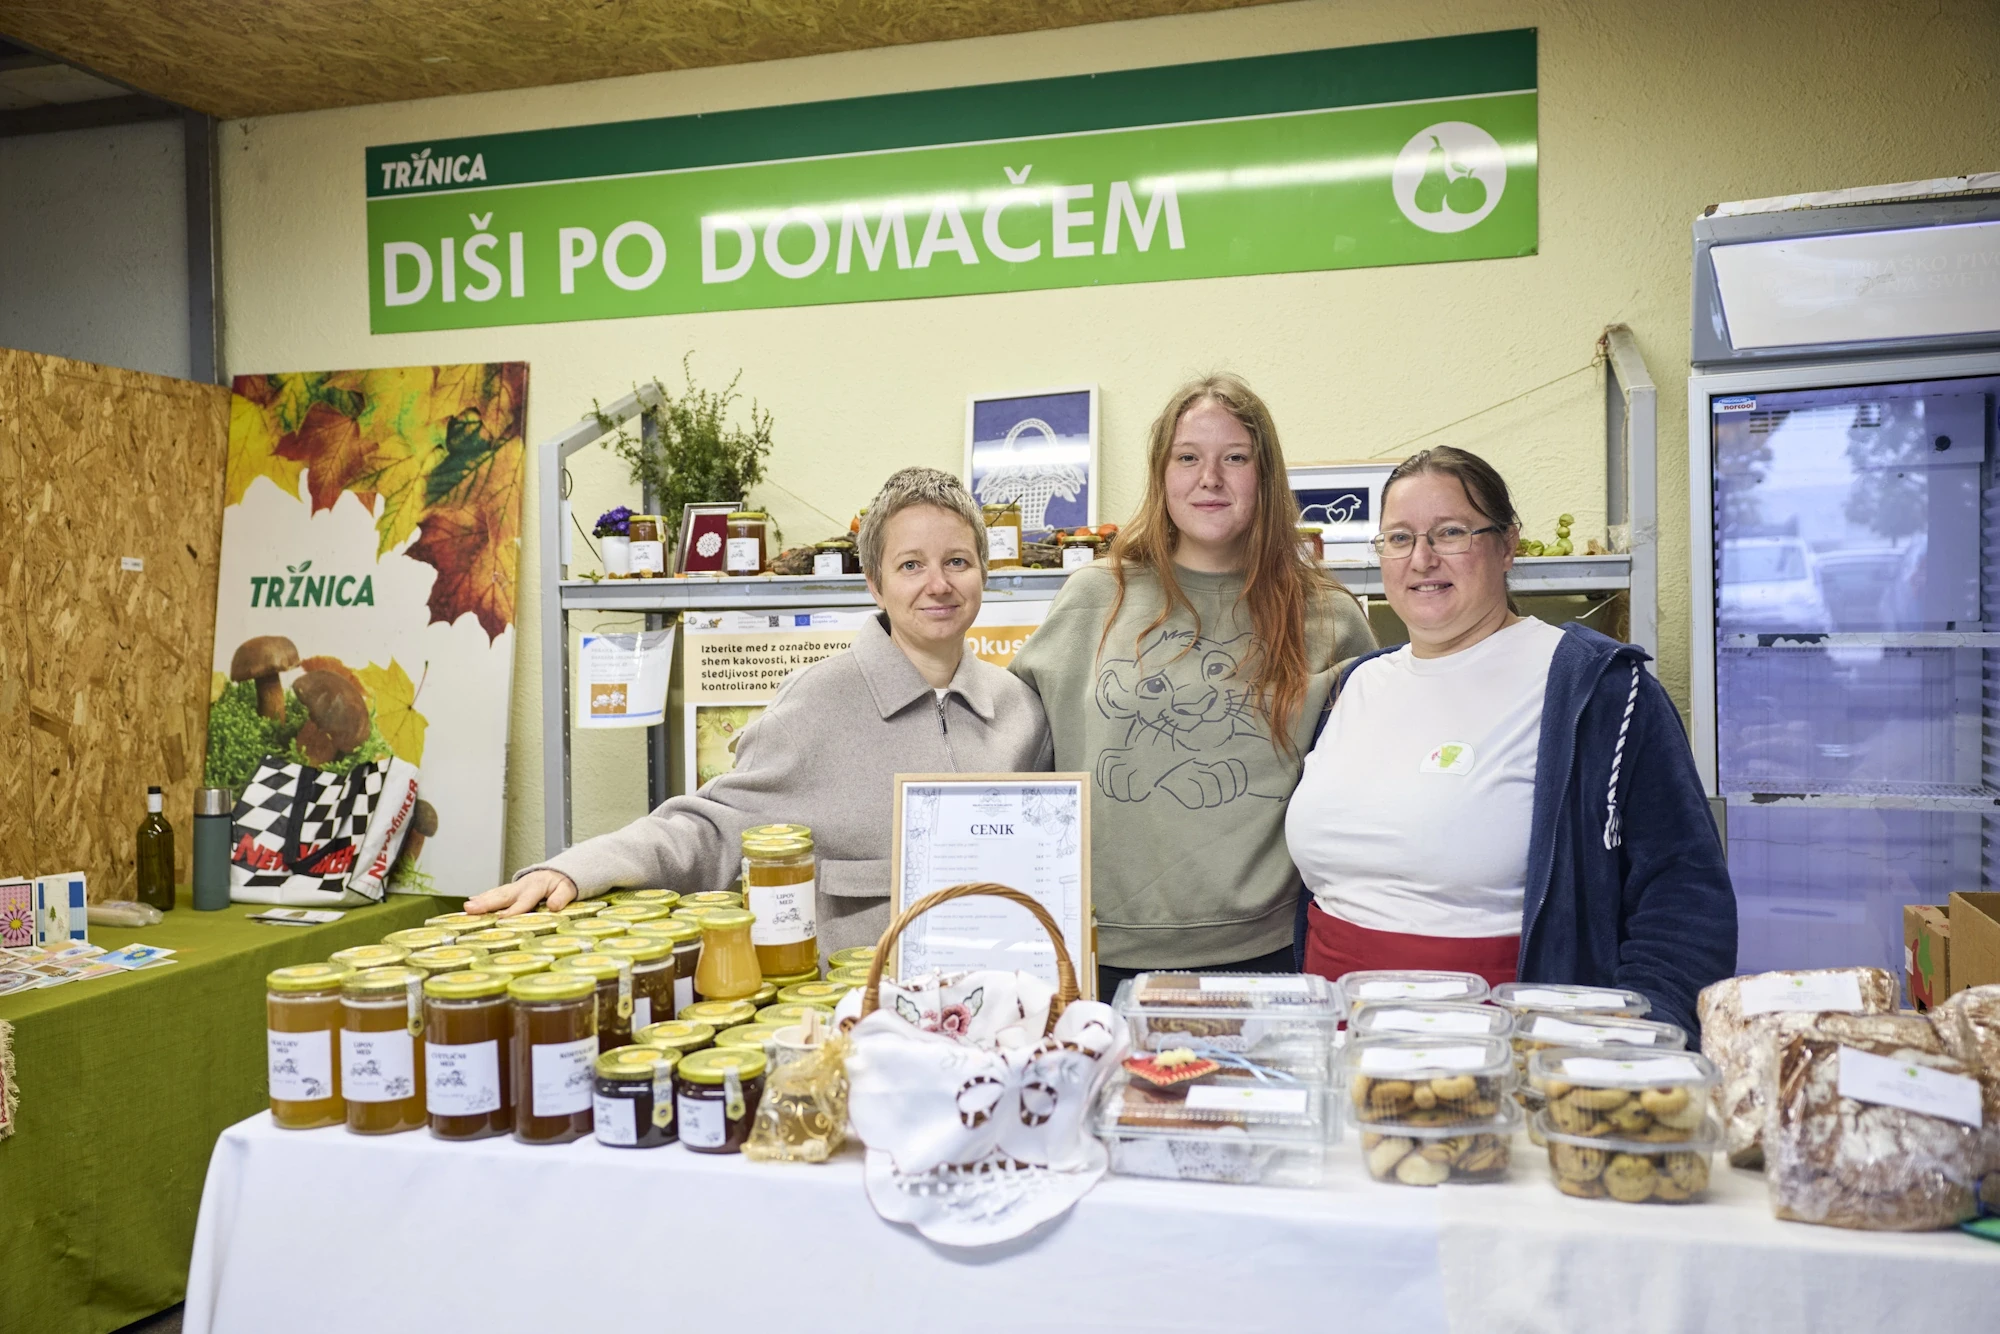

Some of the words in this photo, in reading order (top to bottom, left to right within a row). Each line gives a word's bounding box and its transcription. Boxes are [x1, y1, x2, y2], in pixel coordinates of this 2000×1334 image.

[381, 148, 487, 189] TRŽNICA
[383, 212, 525, 307] DIŠI
[559, 220, 667, 295] PO
[700, 165, 1186, 285] DOMAČEM
[1723, 402, 1754, 411] norcool
[250, 560, 375, 608] TRŽNICA
[701, 644, 743, 653] Izberite
[745, 643, 768, 653] med
[779, 641, 821, 652] označbo
[966, 633, 1032, 655] Okus
[701, 656, 730, 666] shem
[733, 655, 787, 667] kakovosti,
[790, 655, 800, 664] ki
[701, 668, 758, 680] sledljivost
[701, 682, 768, 691] kontrolirano
[970, 823, 1015, 836] CENIK
[776, 892, 796, 900] LIPOV
